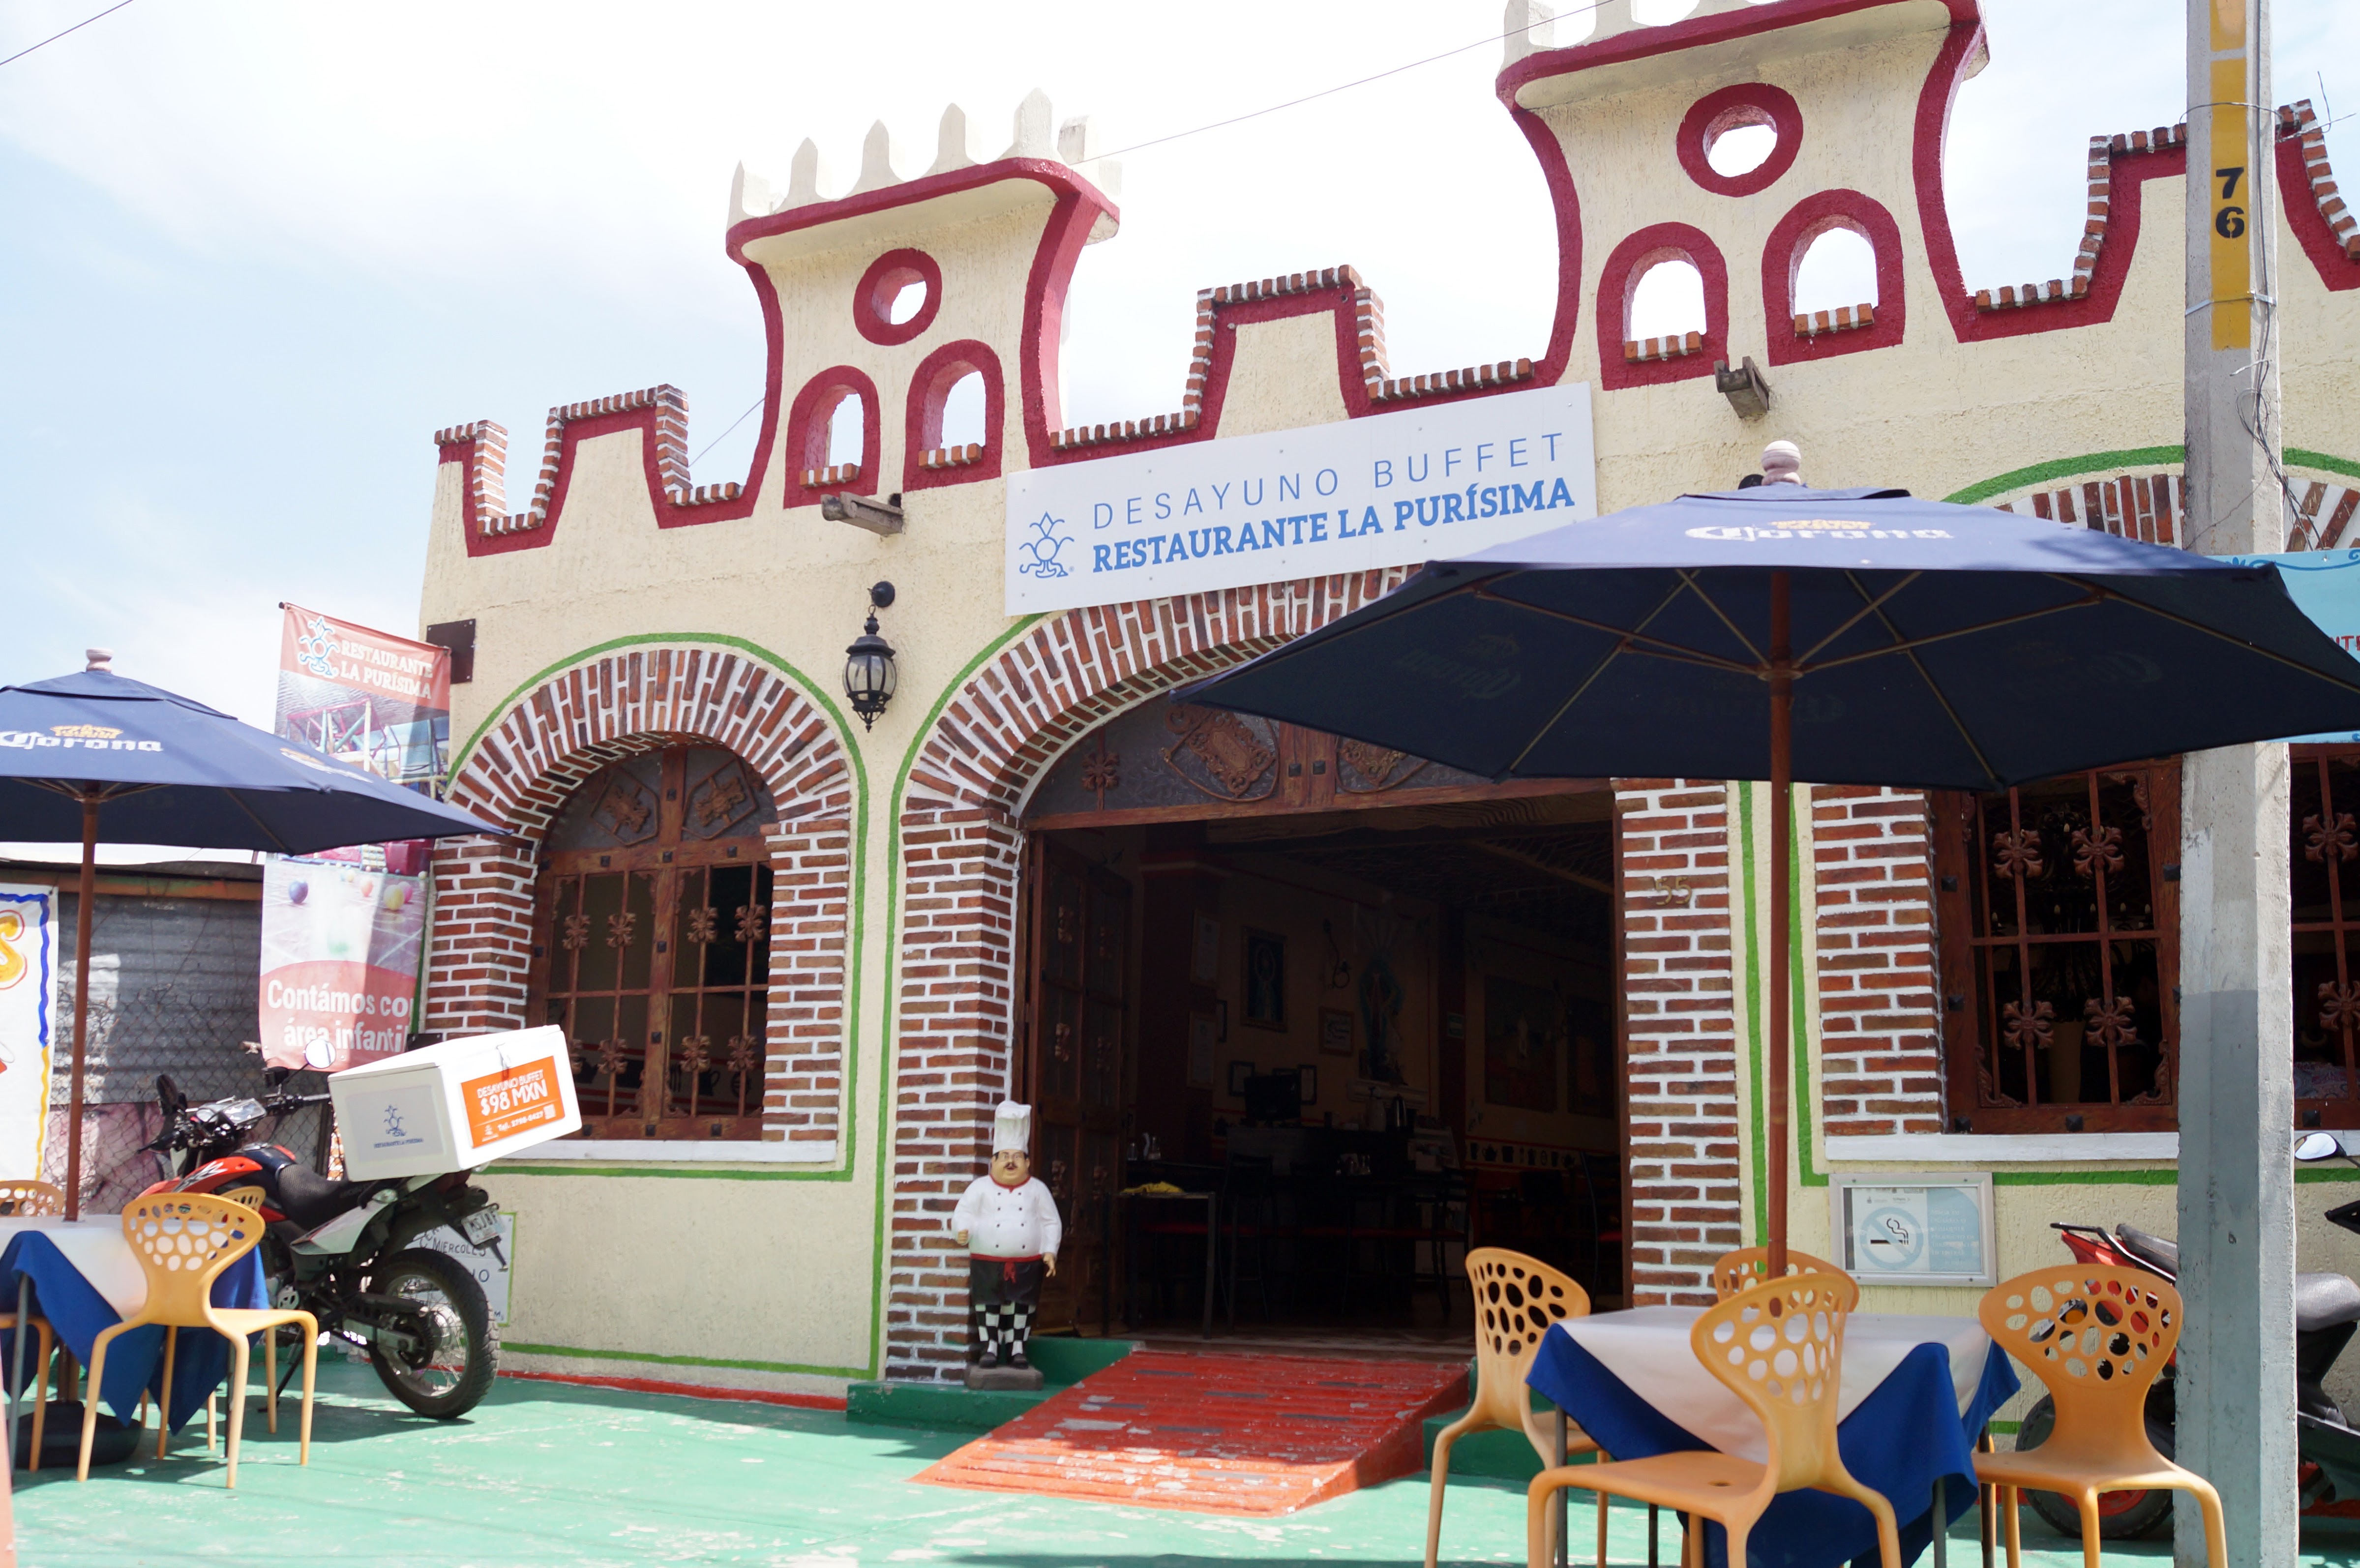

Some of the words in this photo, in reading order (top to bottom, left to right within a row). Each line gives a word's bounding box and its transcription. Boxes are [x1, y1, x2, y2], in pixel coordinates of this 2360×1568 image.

[2215, 167, 2245, 239] 76
[1094, 468, 1339, 530] DESAYUNO
[1374, 432, 1562, 488] BUFFET
[1092, 511, 1328, 573] RESTAURANTE
[1338, 505, 1384, 539] LA
[1393, 476, 1575, 532] PURÍSIMA
[1685, 526, 1954, 541] Corona
[340, 639, 433, 679] RESTAURANTE
[340, 660, 360, 682] LA
[362, 666, 432, 700] PURÍSIMA
[0, 730, 164, 752] Corona
[1655, 876, 1692, 907] 55
[267, 979, 376, 1015] Contámos
[477, 1077, 519, 1098] DESAYUNO
[519, 1069, 544, 1086] BUFFET
[480, 1091, 510, 1117] $98
[511, 1078, 548, 1107] MXN
